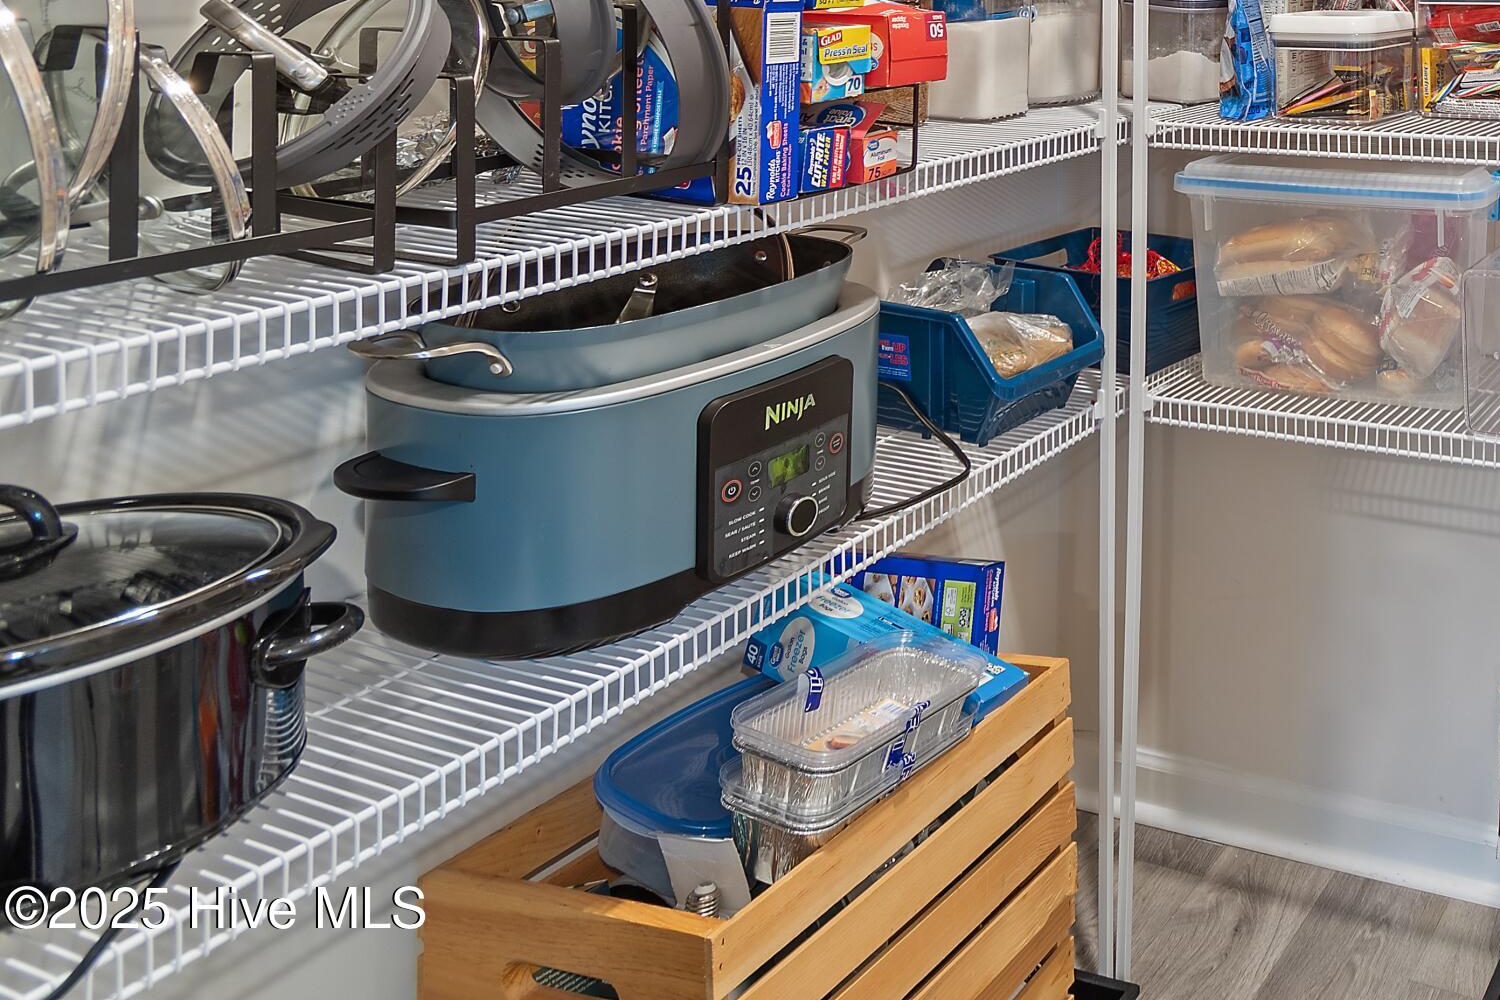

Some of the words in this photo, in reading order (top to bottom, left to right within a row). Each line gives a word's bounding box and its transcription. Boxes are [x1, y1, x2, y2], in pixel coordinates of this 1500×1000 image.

[820, 30, 842, 47] GLAD
[929, 23, 944, 38] 50
[852, 45, 868, 54] Seal
[645, 65, 654, 92] Paper
[847, 77, 860, 92] 70
[641, 93, 652, 146] Parchment
[735, 166, 751, 196] 25
[766, 159, 776, 200] Reynolds
[868, 167, 881, 181] 75
[764, 393, 816, 431] NINJA
[746, 643, 759, 666] 40
[787, 631, 806, 673] Freezer
